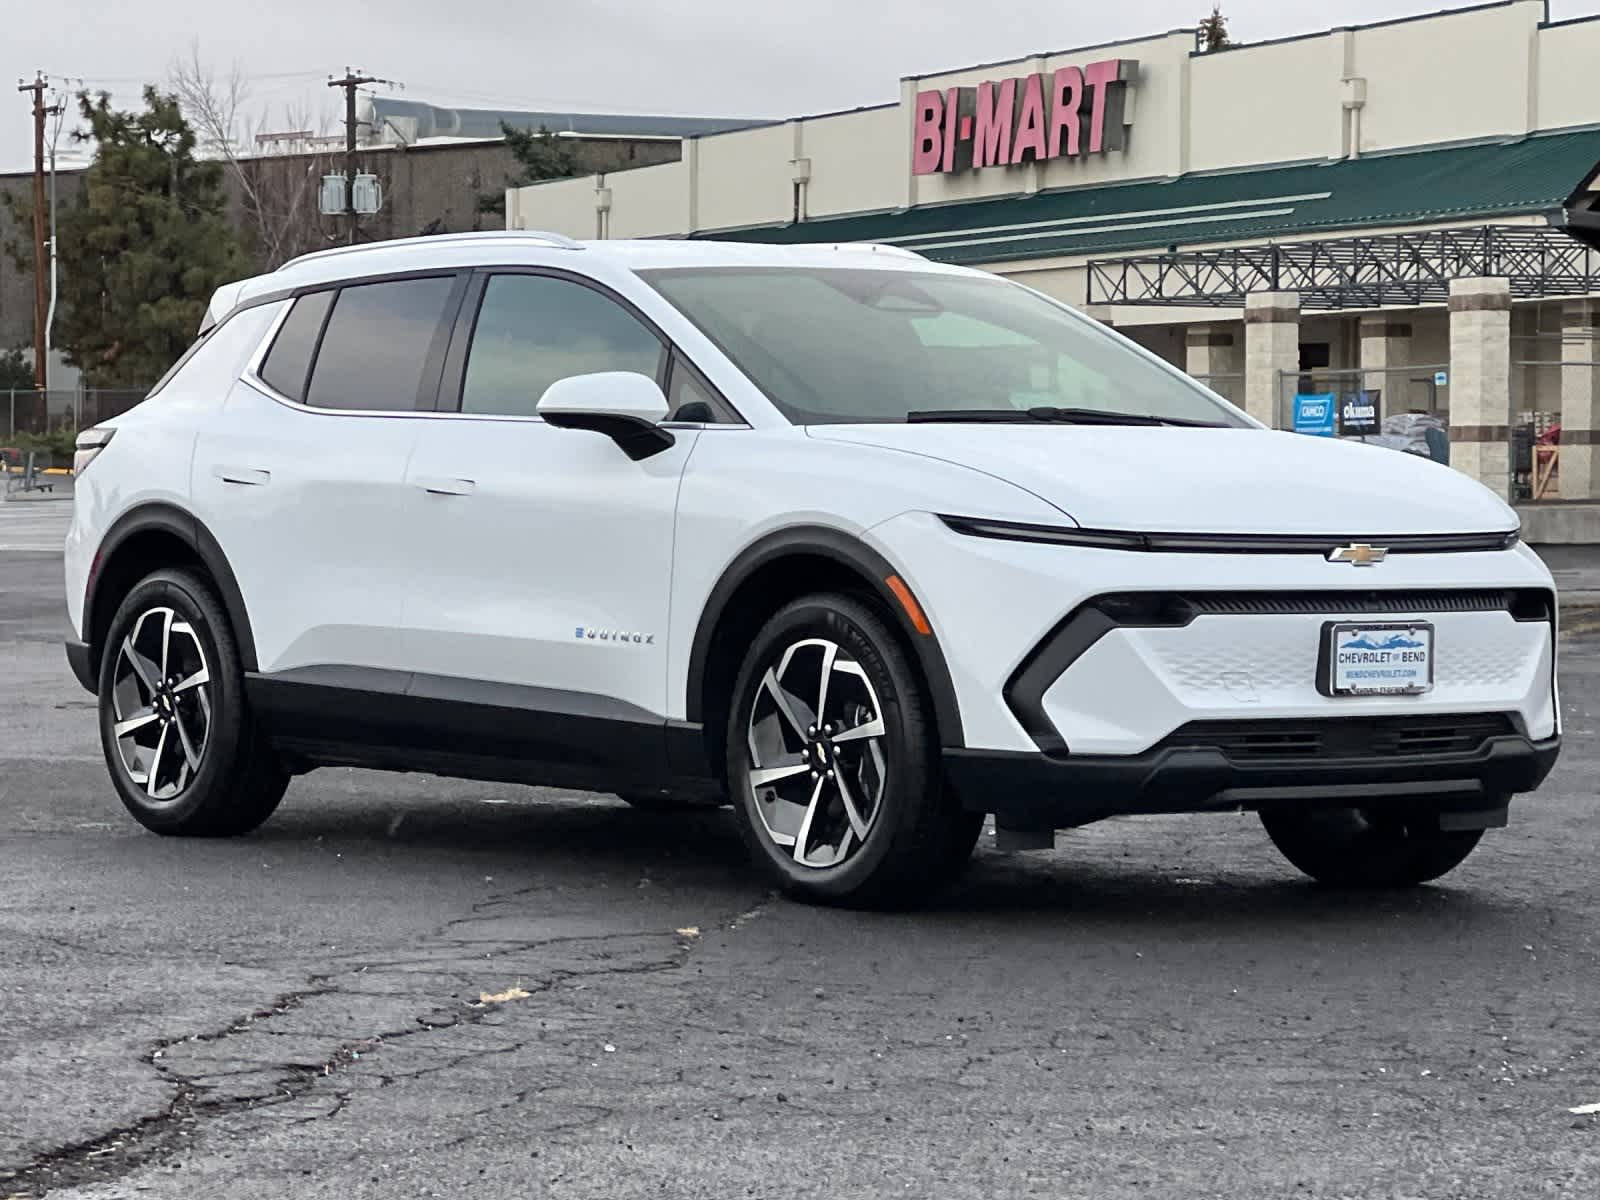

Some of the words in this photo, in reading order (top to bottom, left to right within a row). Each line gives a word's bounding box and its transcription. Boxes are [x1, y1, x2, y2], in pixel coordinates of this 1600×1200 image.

[913, 59, 1121, 175] BI-MART
[1344, 402, 1374, 418] okuma
[1339, 652, 1392, 663] CHEVROLET
[1402, 651, 1426, 662] BEND
